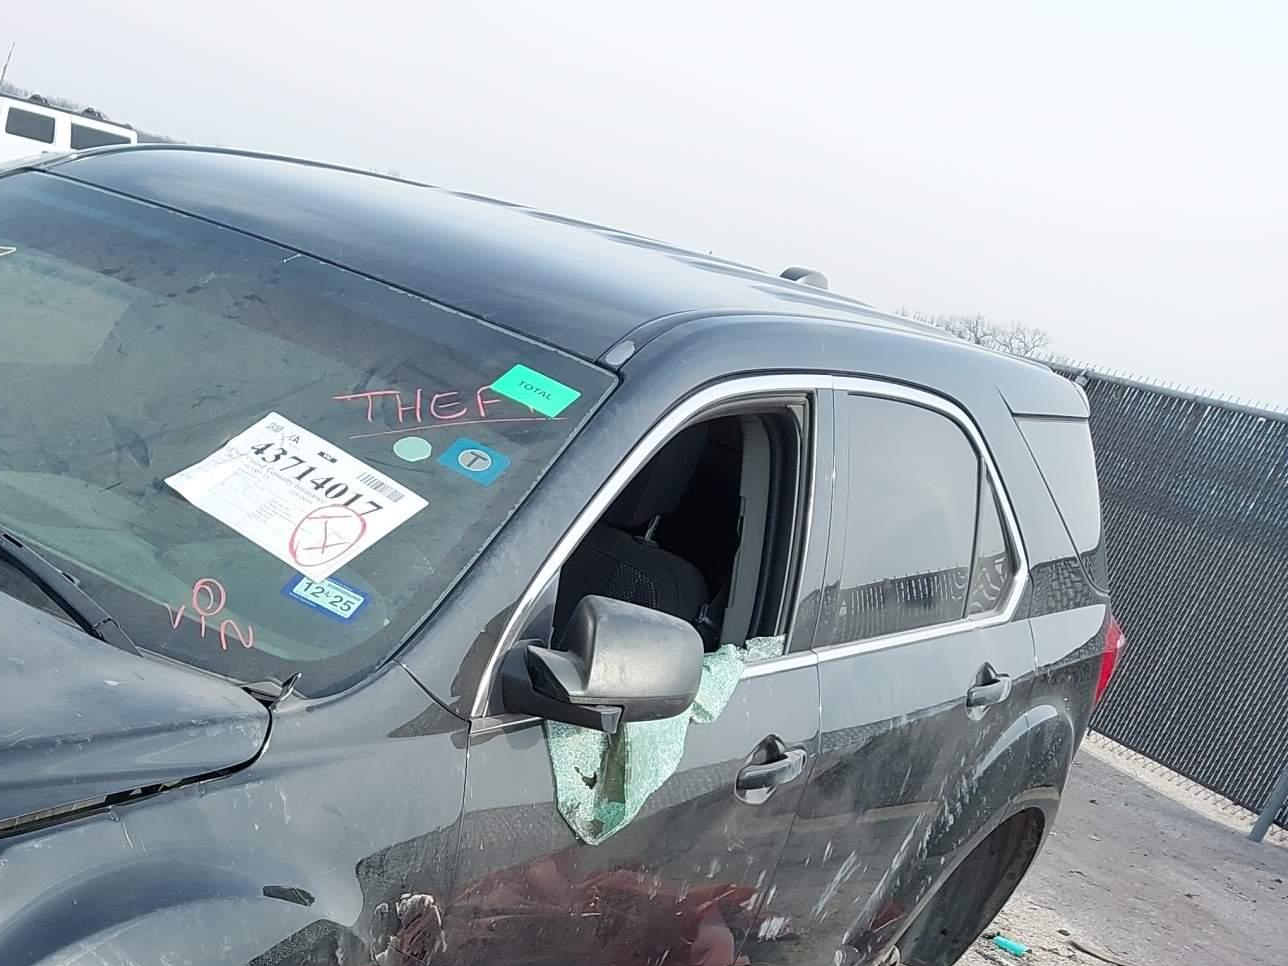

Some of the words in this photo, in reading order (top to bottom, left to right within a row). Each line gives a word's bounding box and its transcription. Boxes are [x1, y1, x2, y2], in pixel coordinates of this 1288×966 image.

[333, 385, 536, 424] THEF
[517, 380, 552, 401] TOTAL
[466, 452, 488, 469] T
[250, 442, 384, 516] 43714017
